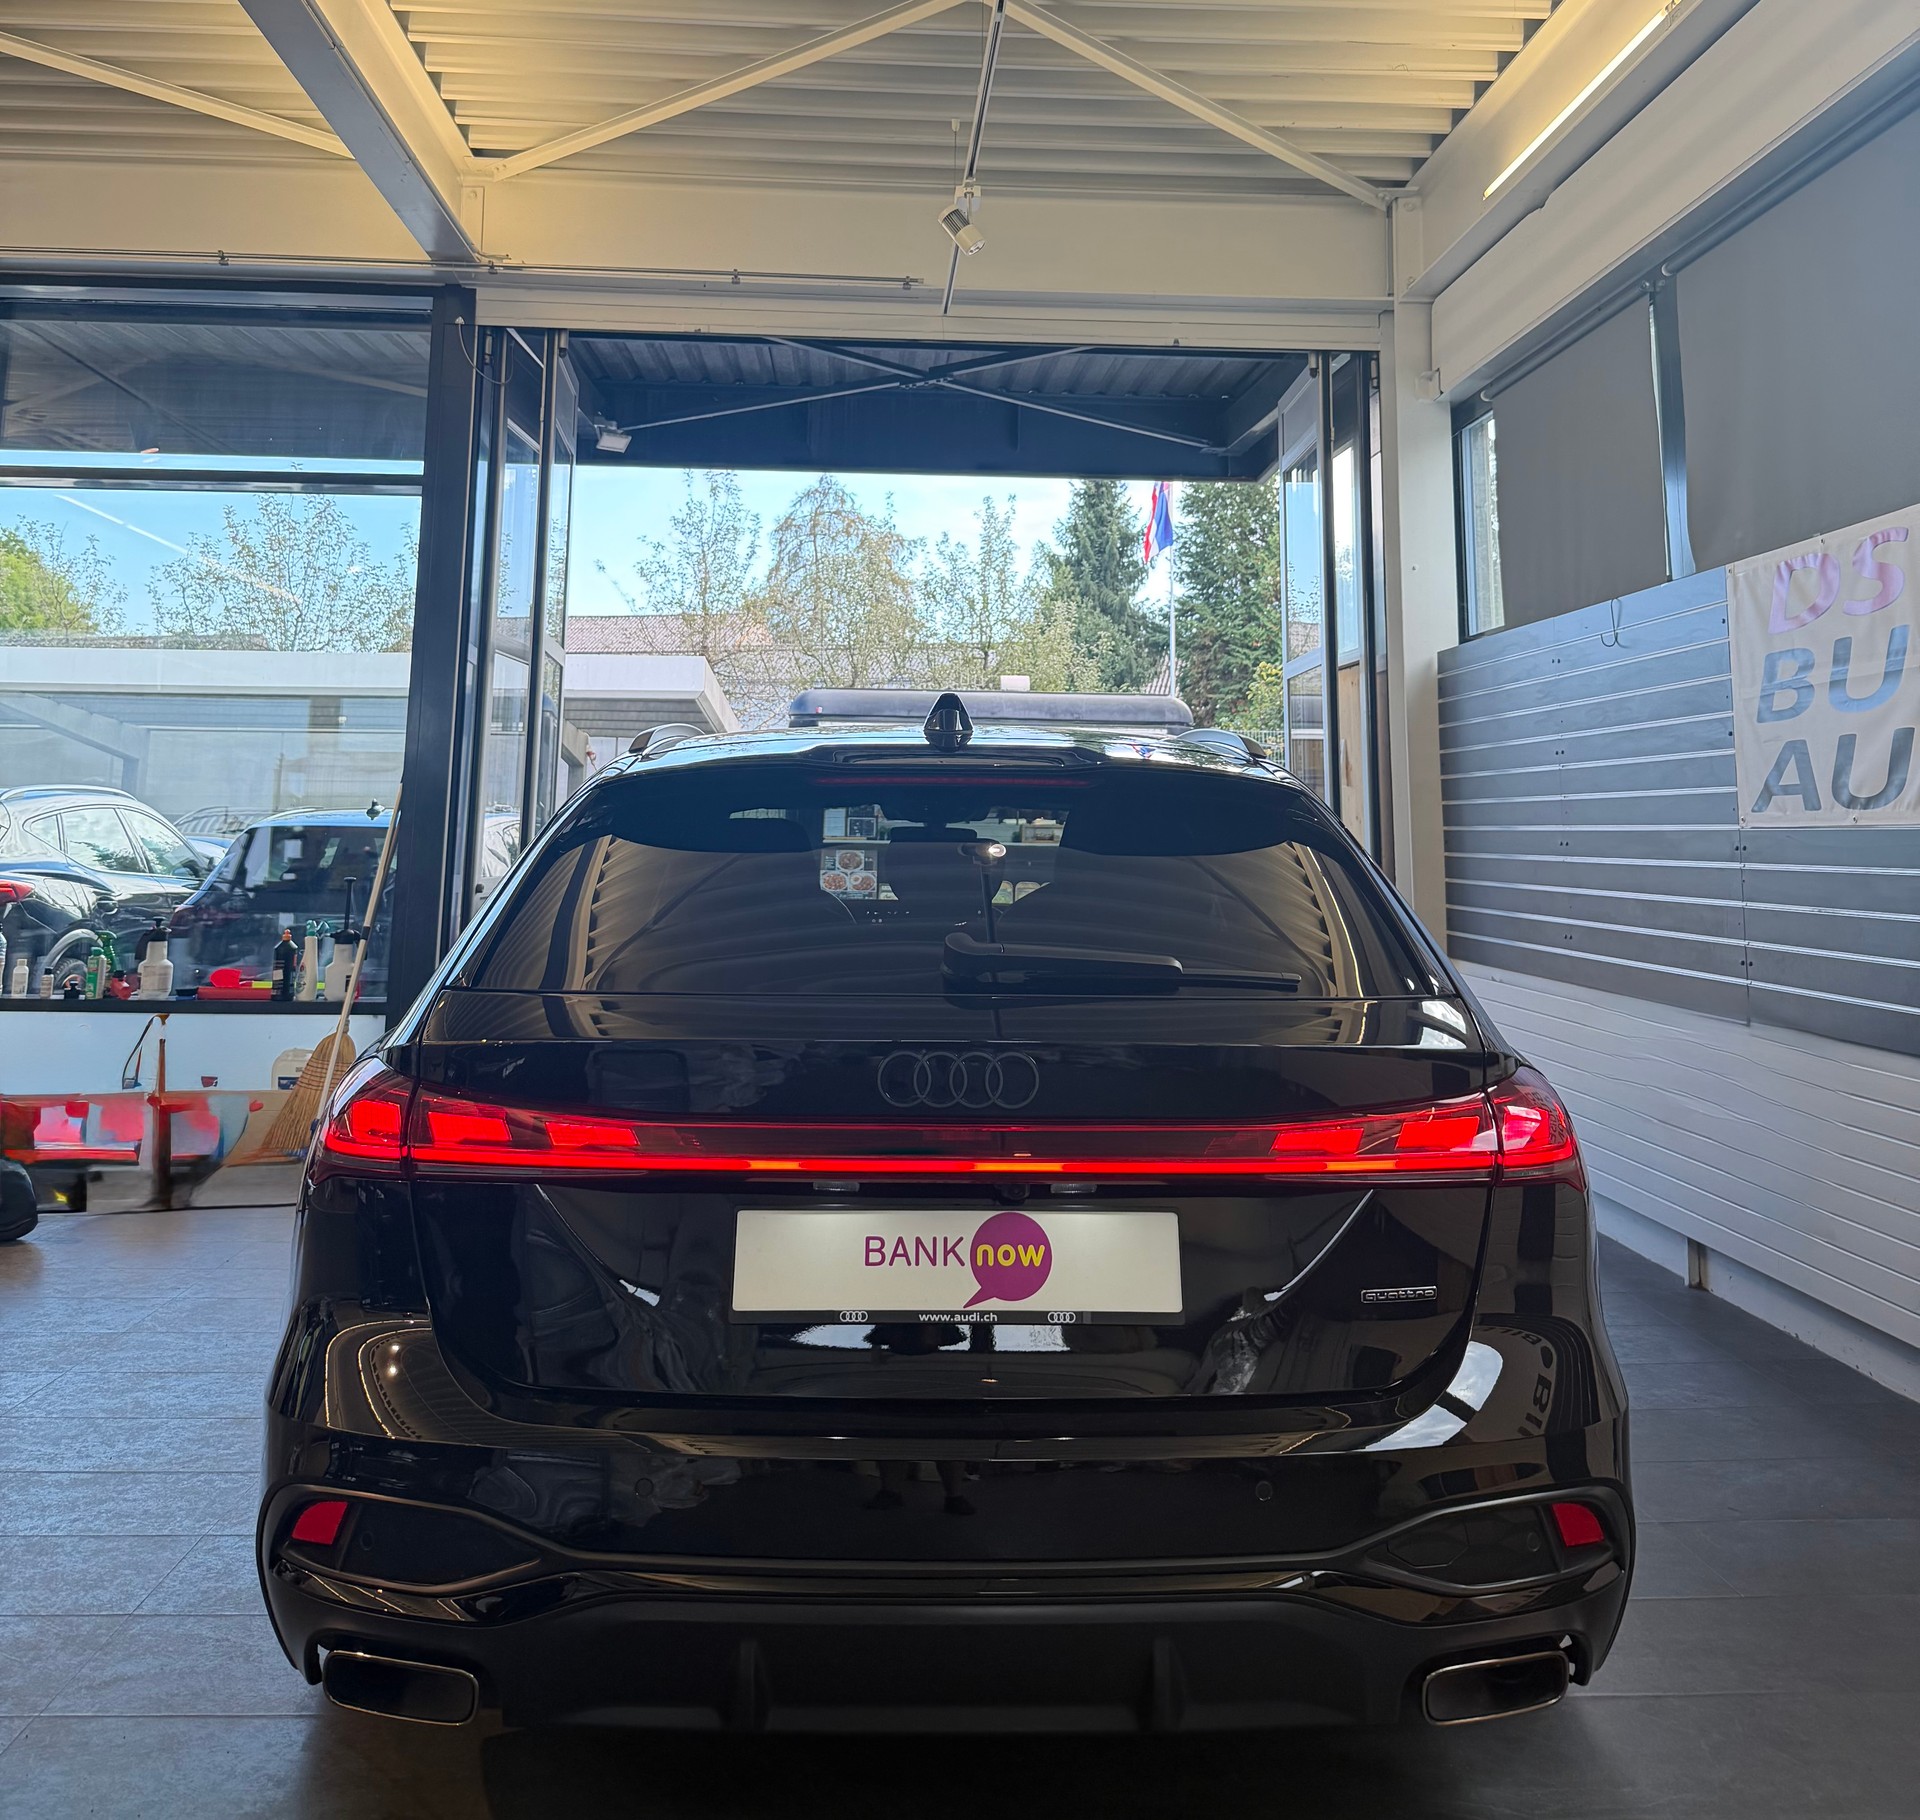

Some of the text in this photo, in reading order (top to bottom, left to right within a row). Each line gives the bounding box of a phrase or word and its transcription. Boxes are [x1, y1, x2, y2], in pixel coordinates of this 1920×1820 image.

[1768, 526, 1909, 635] DS
[864, 1236, 1046, 1267] BANK now
[1365, 1289, 1435, 1301] quattro
[918, 1312, 998, 1322] www.audi.ch
